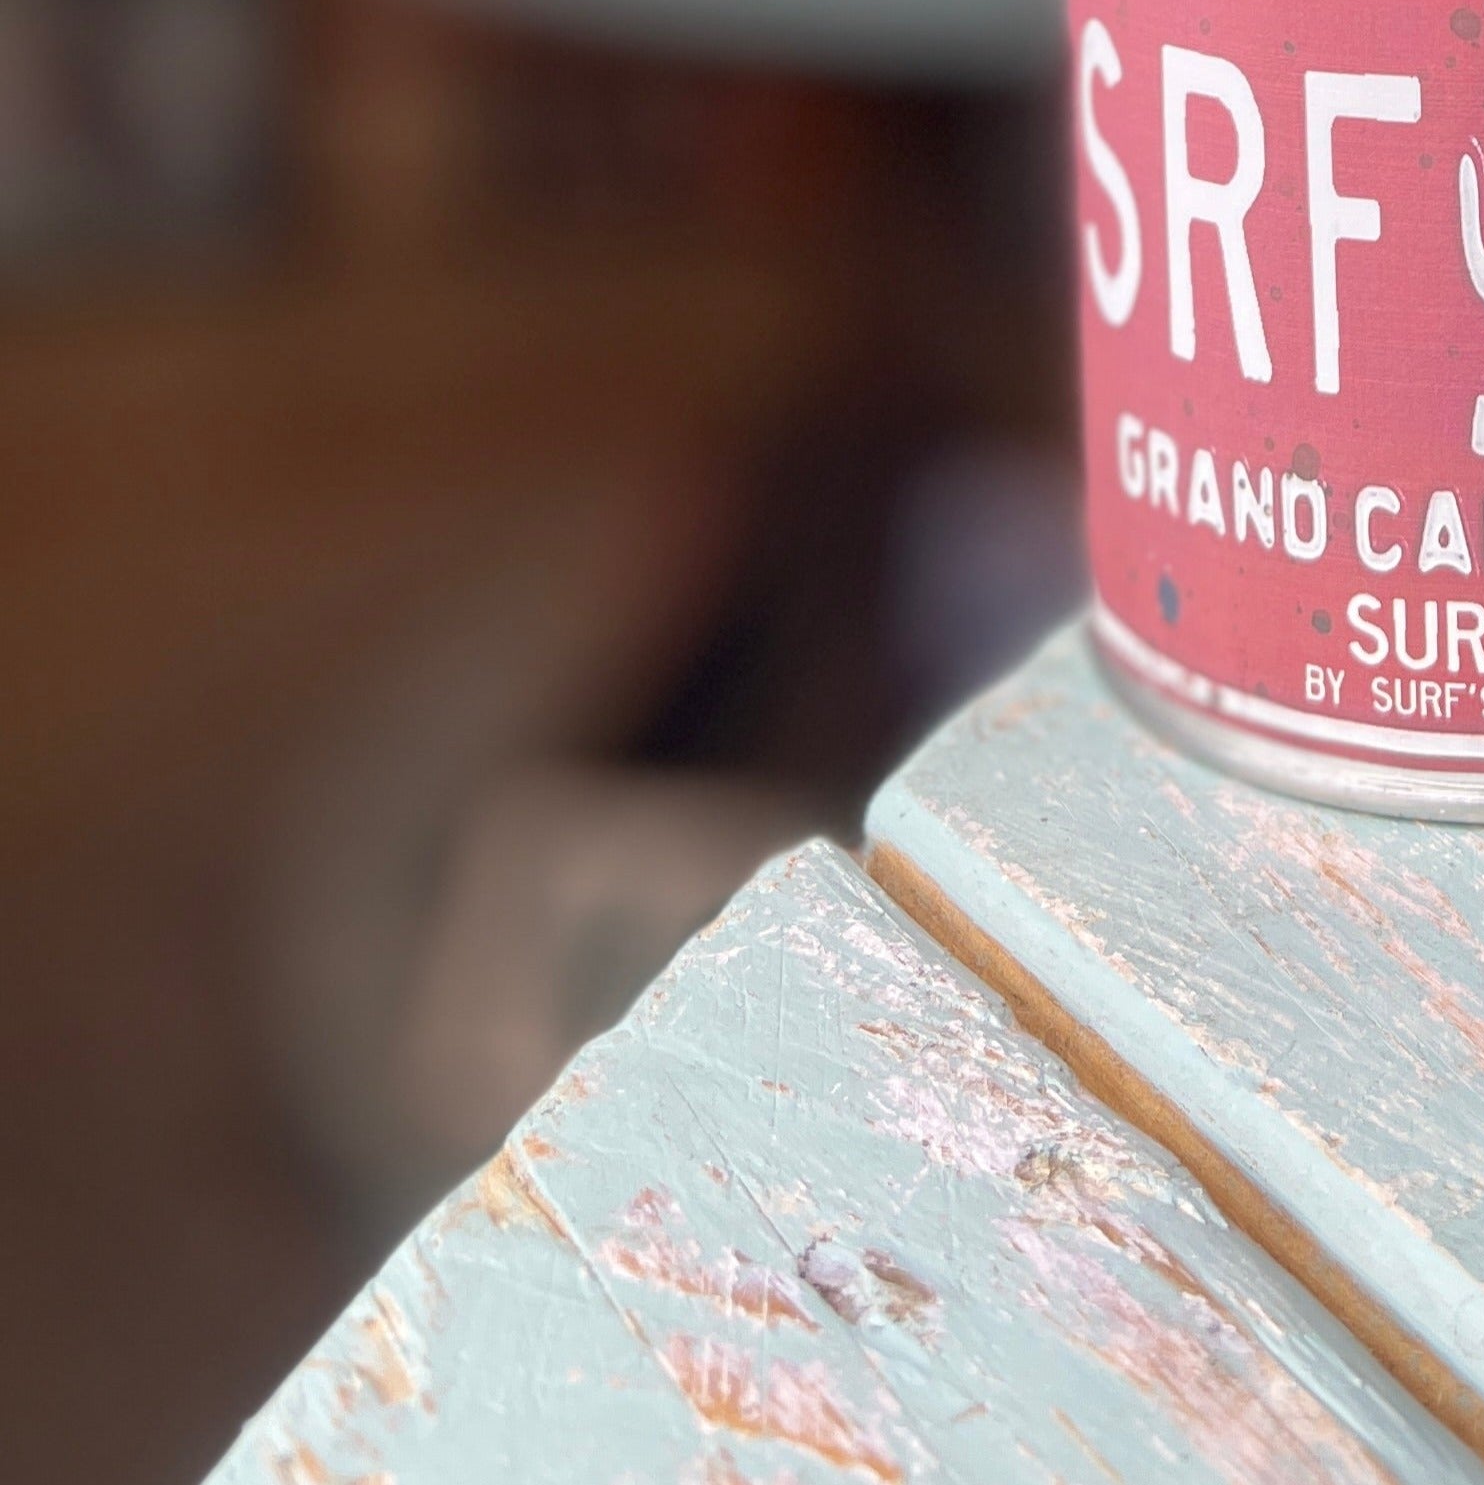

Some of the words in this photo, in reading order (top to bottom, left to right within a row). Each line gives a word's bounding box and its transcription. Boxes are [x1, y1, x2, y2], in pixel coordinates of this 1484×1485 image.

[1080, 18, 1422, 394] SRF
[1117, 412, 1329, 561] GRAND
[1304, 663, 1346, 706] BY
